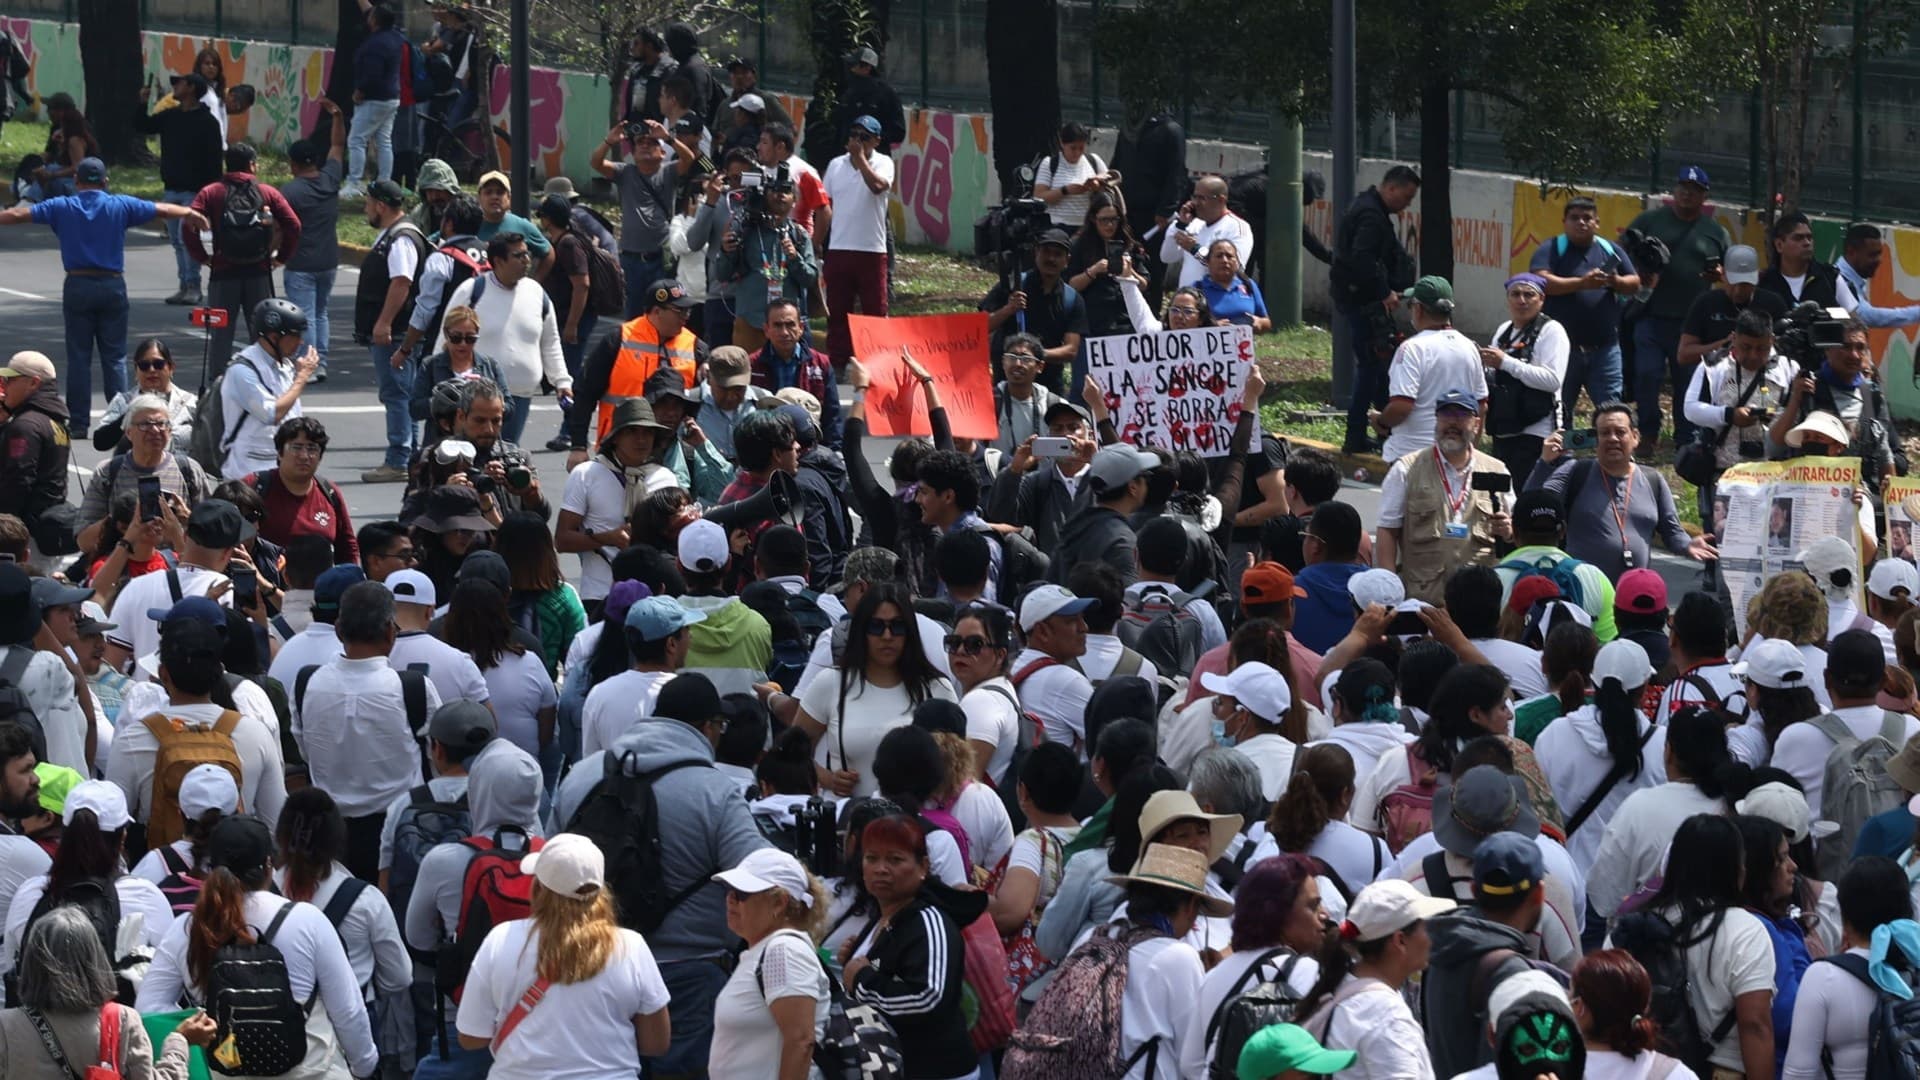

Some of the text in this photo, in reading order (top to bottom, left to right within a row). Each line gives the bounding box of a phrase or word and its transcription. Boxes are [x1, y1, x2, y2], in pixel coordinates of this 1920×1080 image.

[1089, 331, 1232, 367] EL COLOR DE
[1108, 360, 1237, 397] LA SANGRE
[1134, 401, 1158, 427] SE
[1167, 398, 1230, 424] BORRA
[1171, 425, 1232, 452] OLVID
